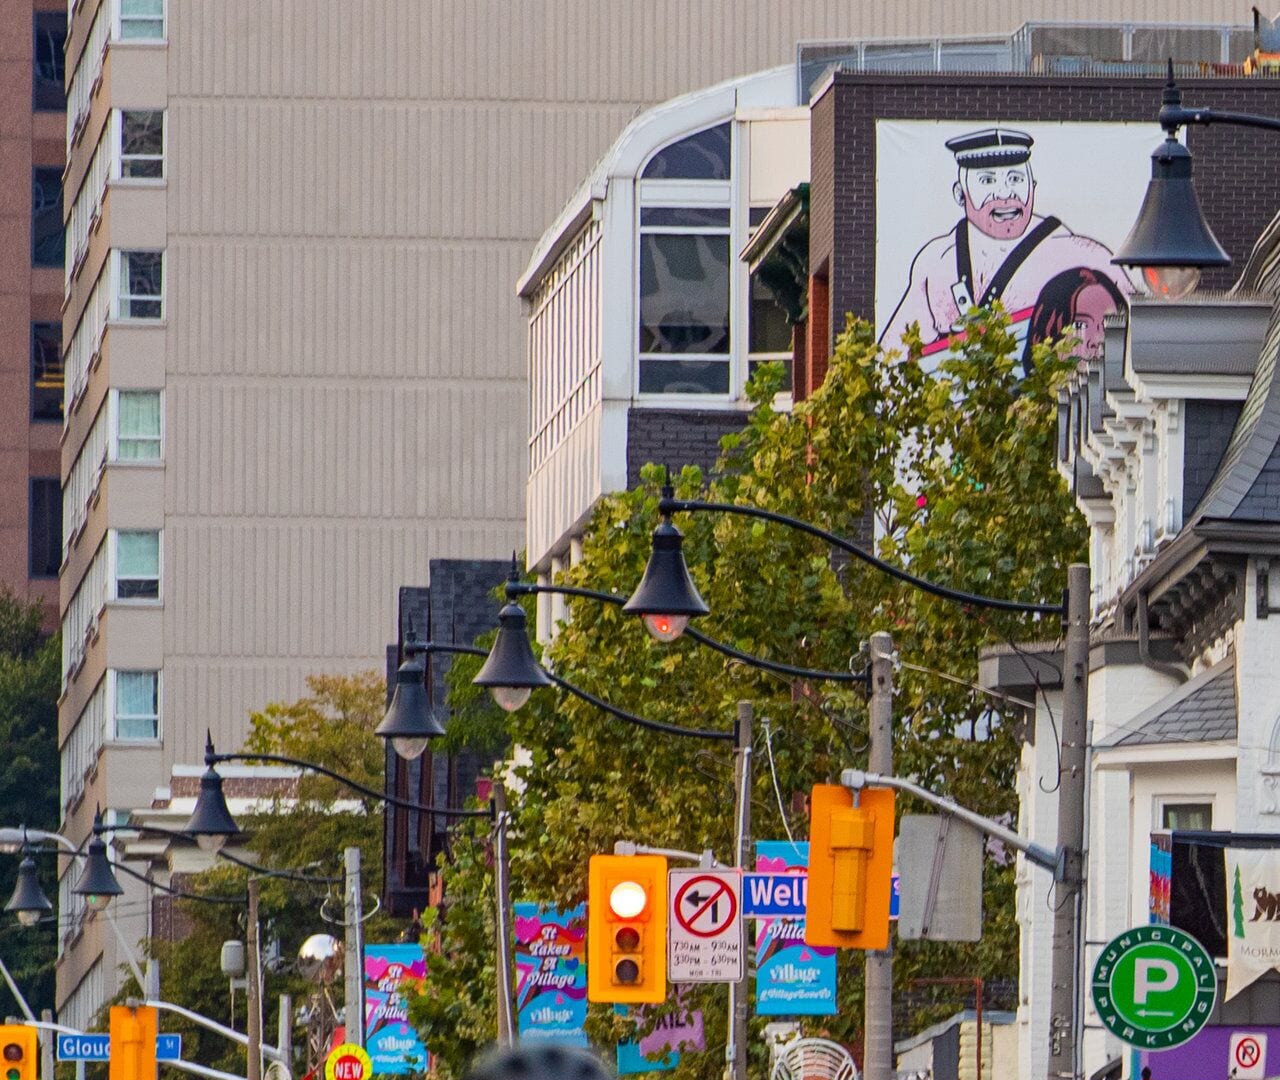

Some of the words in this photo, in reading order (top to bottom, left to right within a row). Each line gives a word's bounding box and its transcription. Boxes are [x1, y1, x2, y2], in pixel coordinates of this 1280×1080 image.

[541, 926, 558, 941] It
[768, 922, 805, 941] Villa
[529, 942, 571, 957] Takes
[1098, 930, 1208, 982] MUNICIPAL
[528, 972, 576, 988] Village
[769, 963, 821, 982] village
[1098, 996, 1208, 1046] PARKING
[335, 1062, 362, 1080] NEW
